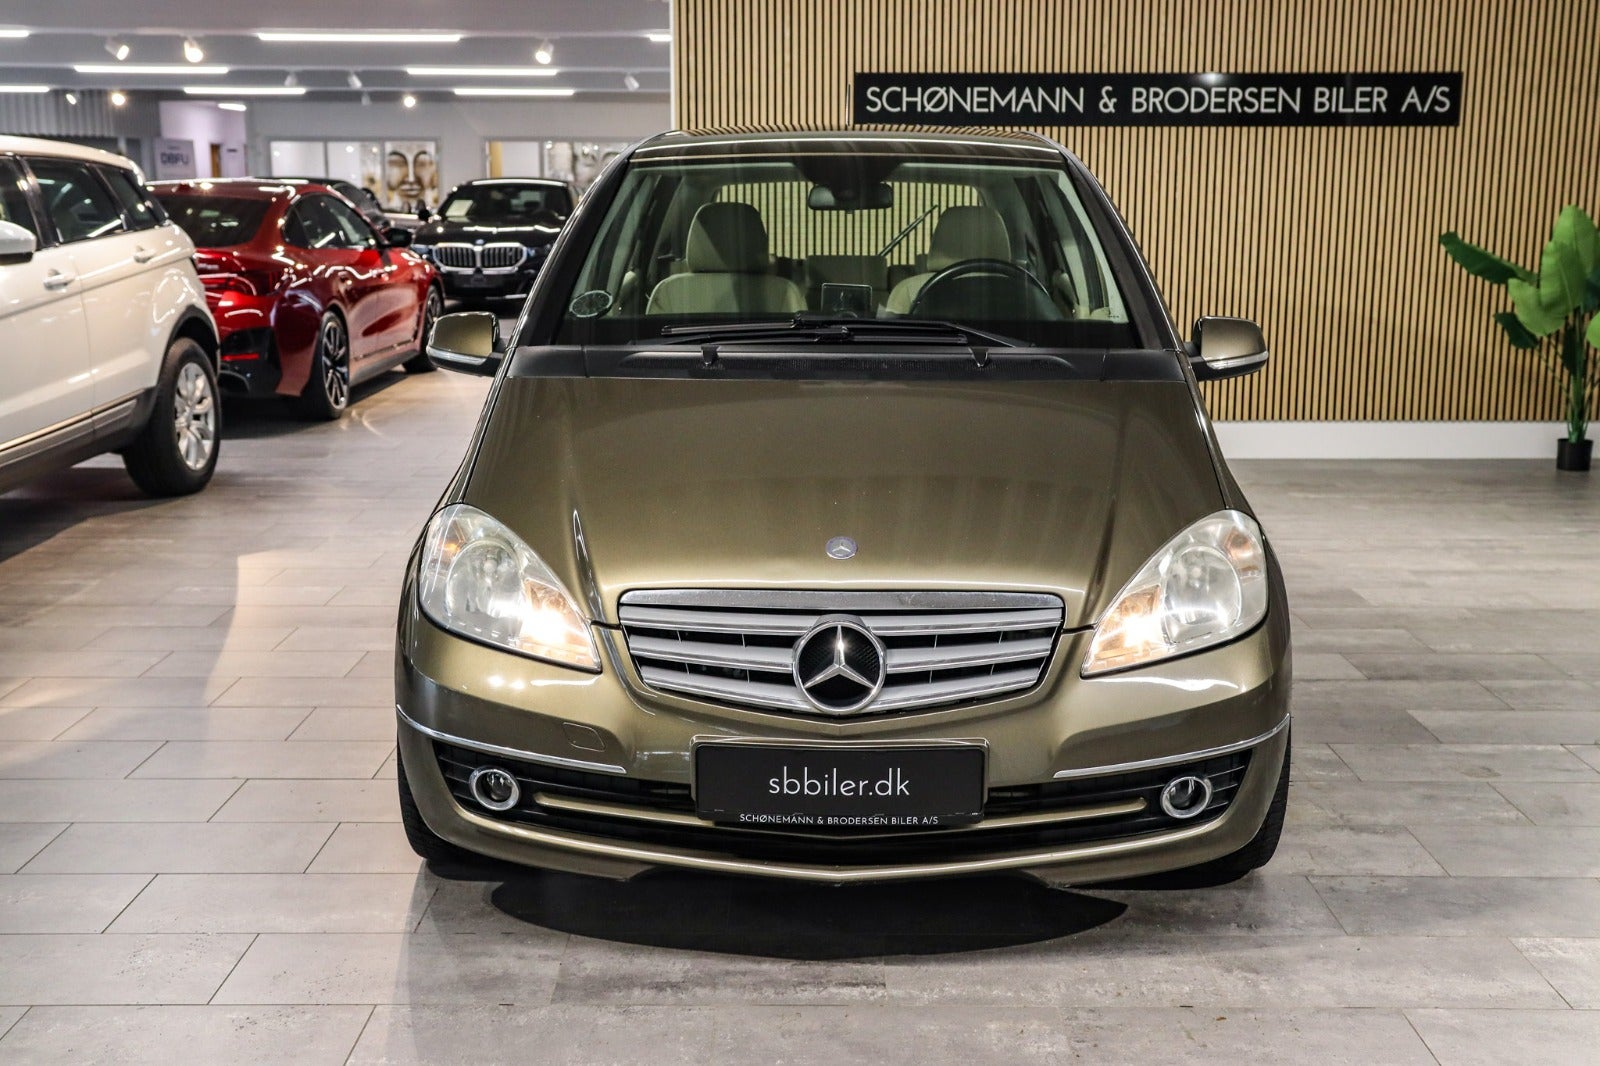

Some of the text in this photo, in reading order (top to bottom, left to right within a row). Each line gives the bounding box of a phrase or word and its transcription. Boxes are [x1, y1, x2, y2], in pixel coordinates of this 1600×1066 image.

[865, 86, 1450, 113] SCHØNEMANN & BRODERSEN BILER A/S
[768, 766, 910, 797] sbbiler.dk
[739, 813, 939, 826] SCHØNEMANN & BRODERSEN BILER A/S
